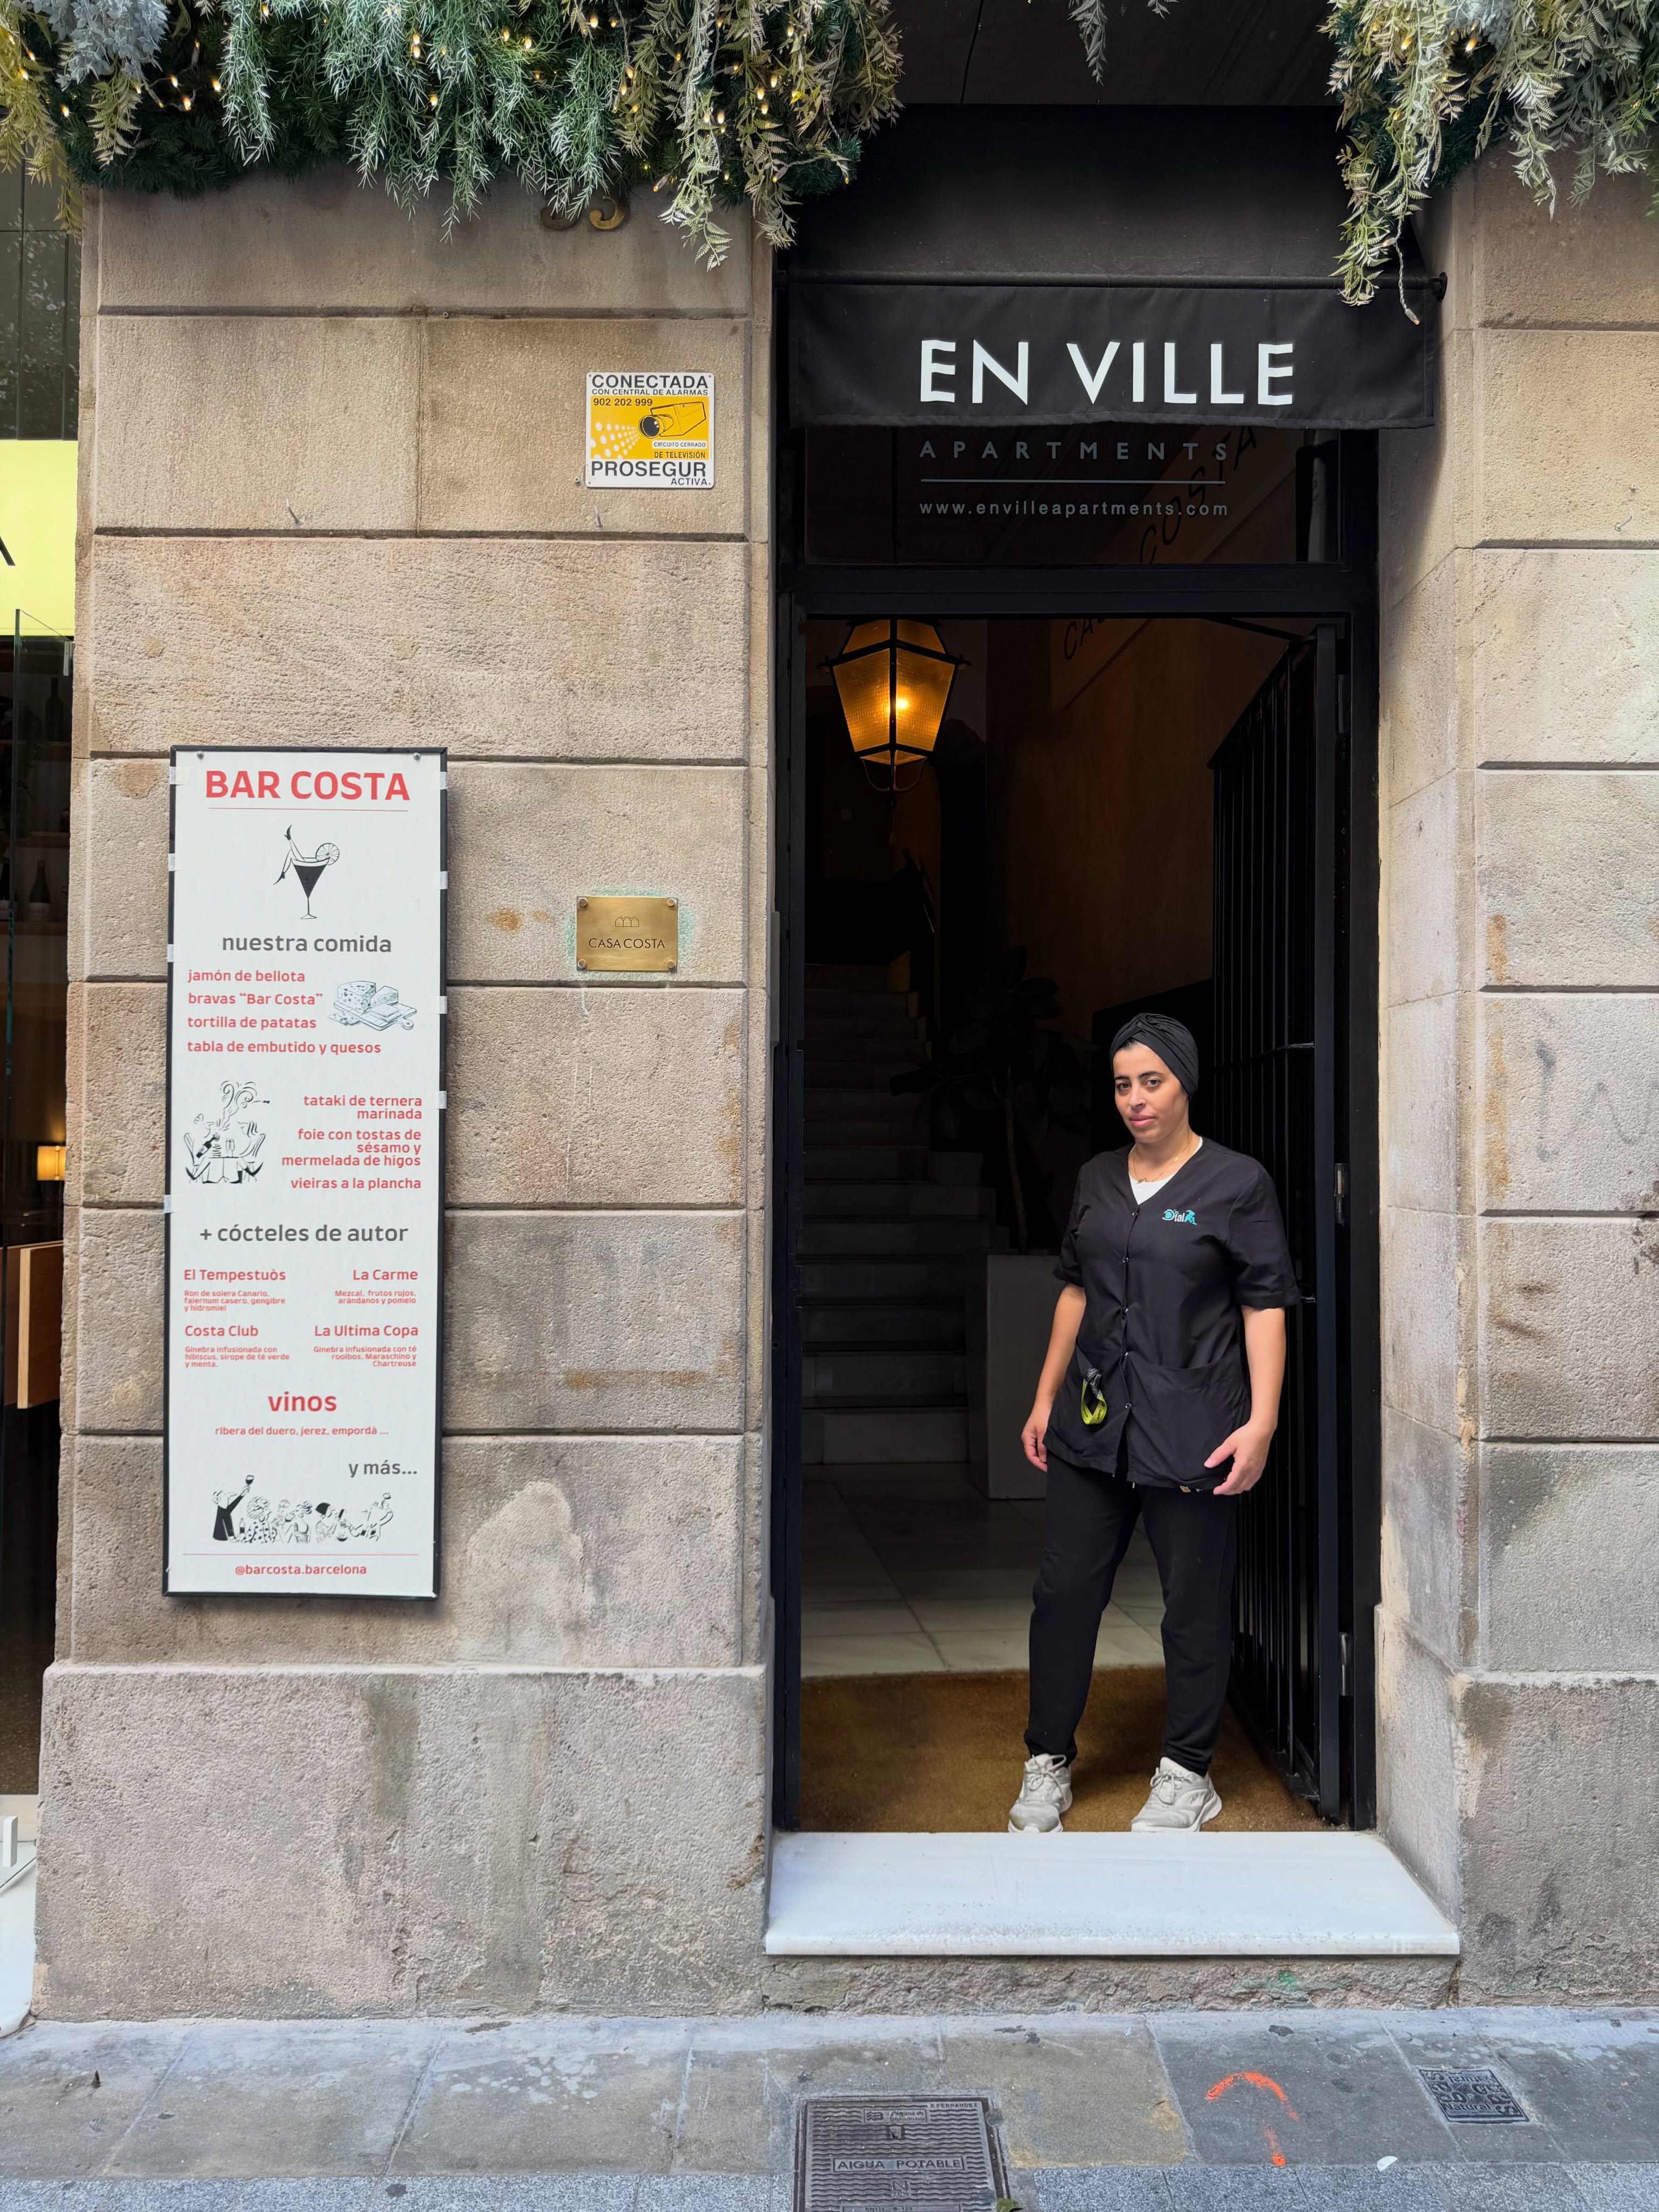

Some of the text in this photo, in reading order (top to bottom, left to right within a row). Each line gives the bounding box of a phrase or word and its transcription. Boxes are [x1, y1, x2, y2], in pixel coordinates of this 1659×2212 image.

[920, 339, 1293, 406] EN VILLE
[592, 374, 709, 388] CONECTADA
[593, 398, 611, 406] 902
[614, 398, 632, 406] 202
[665, 450, 705, 458] TELEVISIÓN
[919, 441, 1227, 461] APARTMENTS
[591, 461, 706, 477] PROSEGUR
[919, 500, 1228, 518] www.envilleapartments.com
[206, 771, 410, 800] BAR COSTA
[223, 935, 391, 952] nuestra comida
[589, 938, 665, 949] CASA COSTA
[188, 970, 305, 983] jamón de bellota
[189, 993, 235, 1004] bravas
[188, 1016, 316, 1030] tortilla de patatas
[187, 1041, 381, 1055] tabla de embutido y quesos
[304, 1095, 422, 1106] tataki de ternera
[358, 1108, 421, 1119] marinada
[298, 1129, 421, 1140] foie con tostas de
[358, 1142, 421, 1155] sésamo y
[282, 1155, 420, 1168] mermelada de higos
[291, 1178, 421, 1191] vieiras a la plancha
[218, 1224, 308, 1241] cócteles
[316, 1225, 341, 1241] de
[348, 1226, 408, 1241] autor
[185, 1269, 195, 1280] El
[353, 1270, 417, 1280] La Carme
[185, 1325, 258, 1336] Costa Club
[315, 1325, 418, 1338] La Ultima Copa
[268, 1391, 336, 1412] vinos
[248, 1427, 263, 1435] del
[349, 1464, 359, 1478] y
[235, 1564, 366, 1575] @barcosta.barcelona
[1441, 2102, 1492, 2111] Natural
[838, 2160, 961, 2170] AIGUA POTABLE
